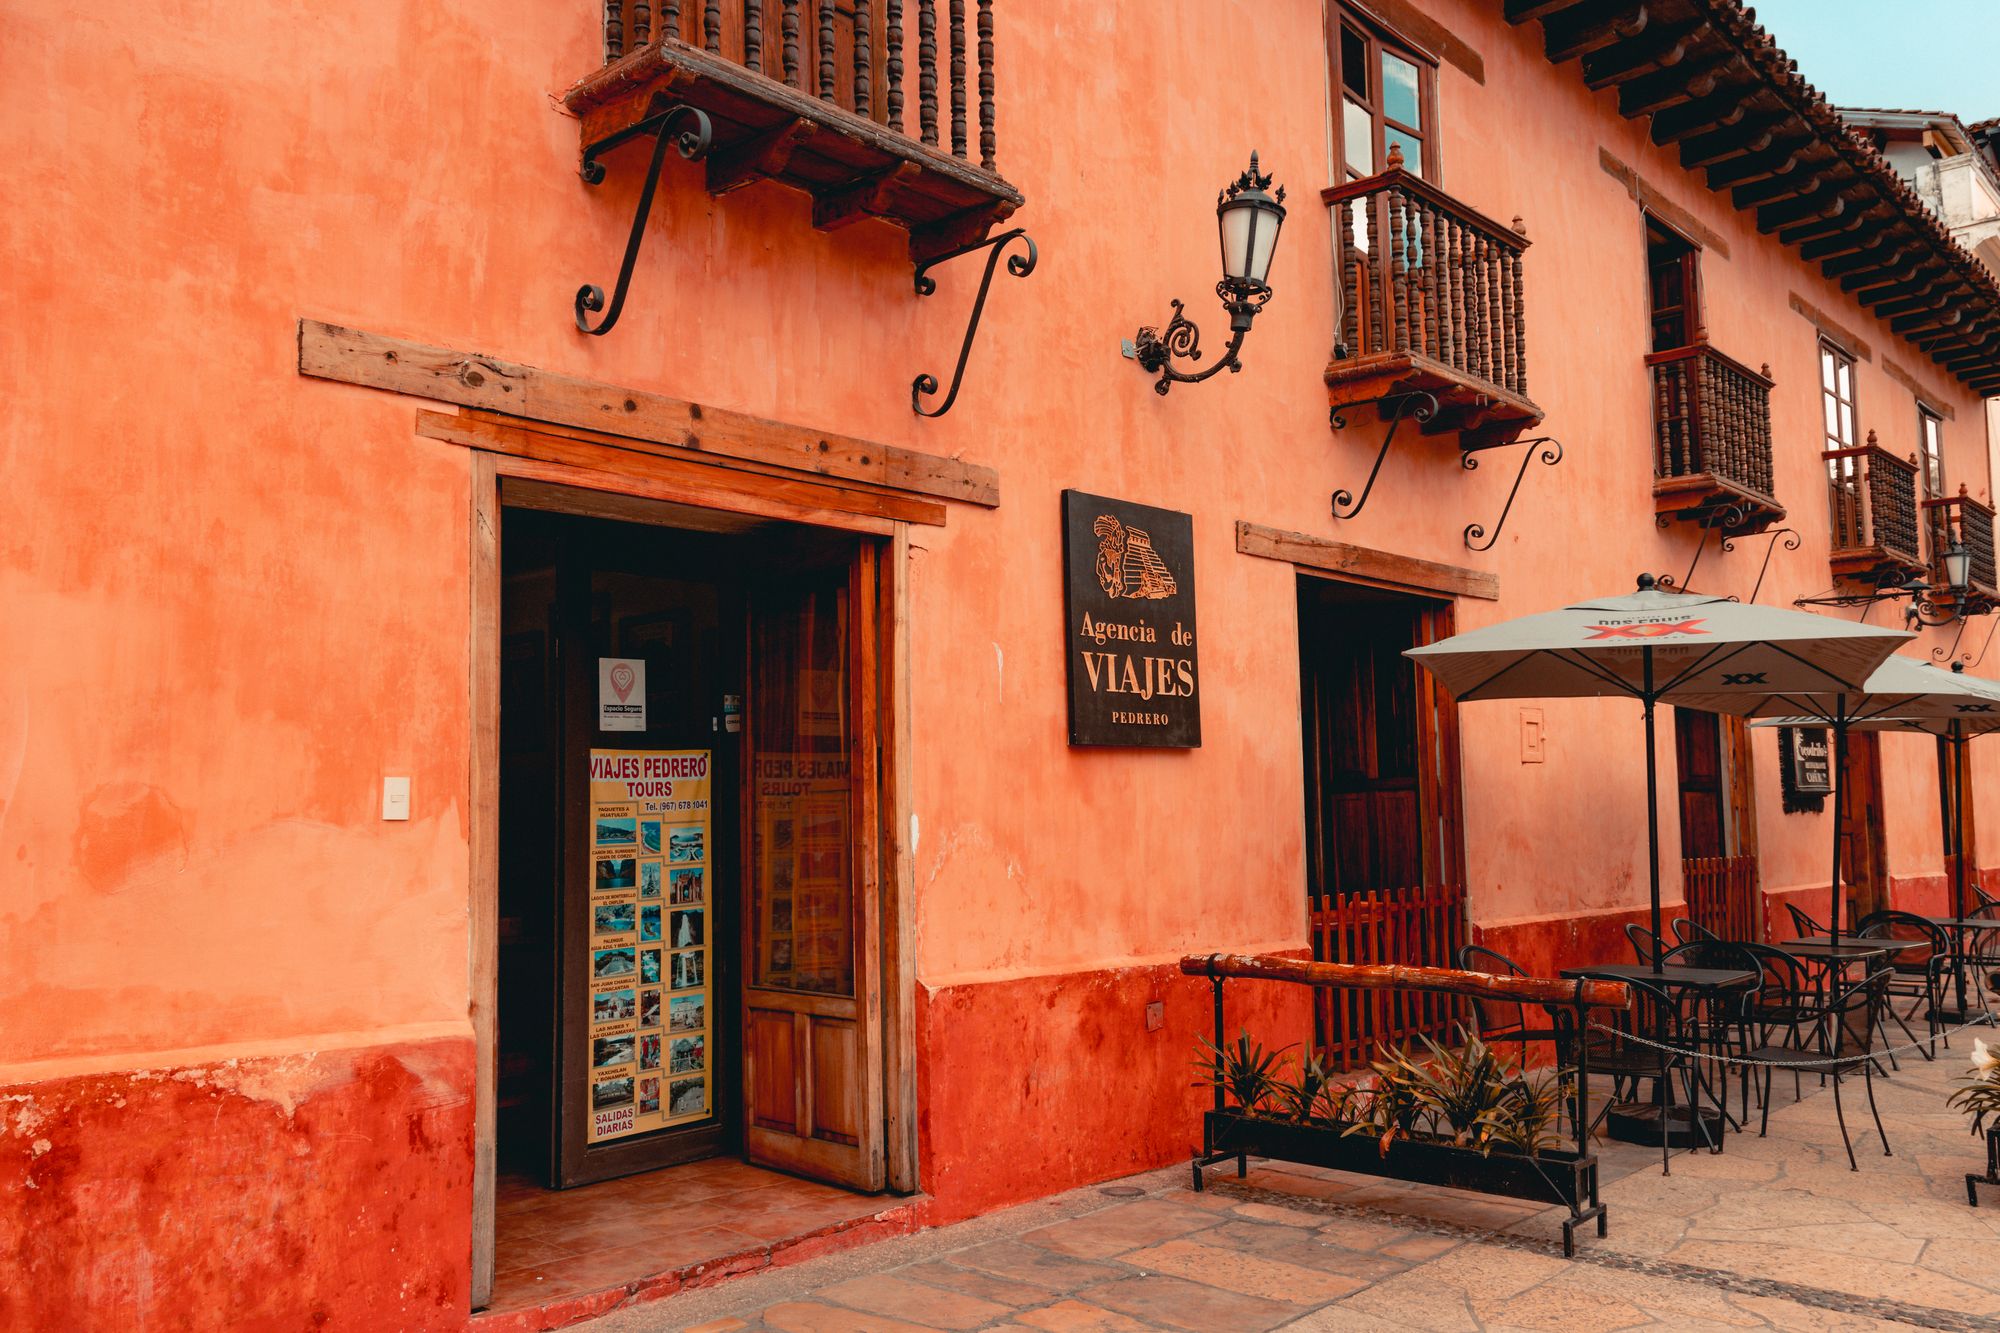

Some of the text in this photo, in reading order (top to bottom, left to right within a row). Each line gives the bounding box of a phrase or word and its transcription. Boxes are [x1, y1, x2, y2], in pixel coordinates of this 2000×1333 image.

[1080, 611, 1192, 646] Agencia de
[1582, 618, 1713, 640] XX
[1081, 651, 1194, 701] VIAJES
[1721, 672, 1770, 686] XX
[604, 705, 642, 713] Espacio Seguro
[1112, 711, 1169, 726] PEDRERO
[590, 757, 707, 779] VIAJES PEDRERO
[627, 781, 672, 797] TOURS
[645, 800, 708, 812] Tel. (967) 678 1041
[600, 1028, 636, 1037] GUACAMAYAS
[607, 1023, 625, 1031] NUBES
[597, 1067, 627, 1076] YAXCHILAN
[600, 1073, 629, 1081] BONAMPAK
[595, 1108, 634, 1125] SALIDAS
[597, 1119, 634, 1136] DIARIAS
